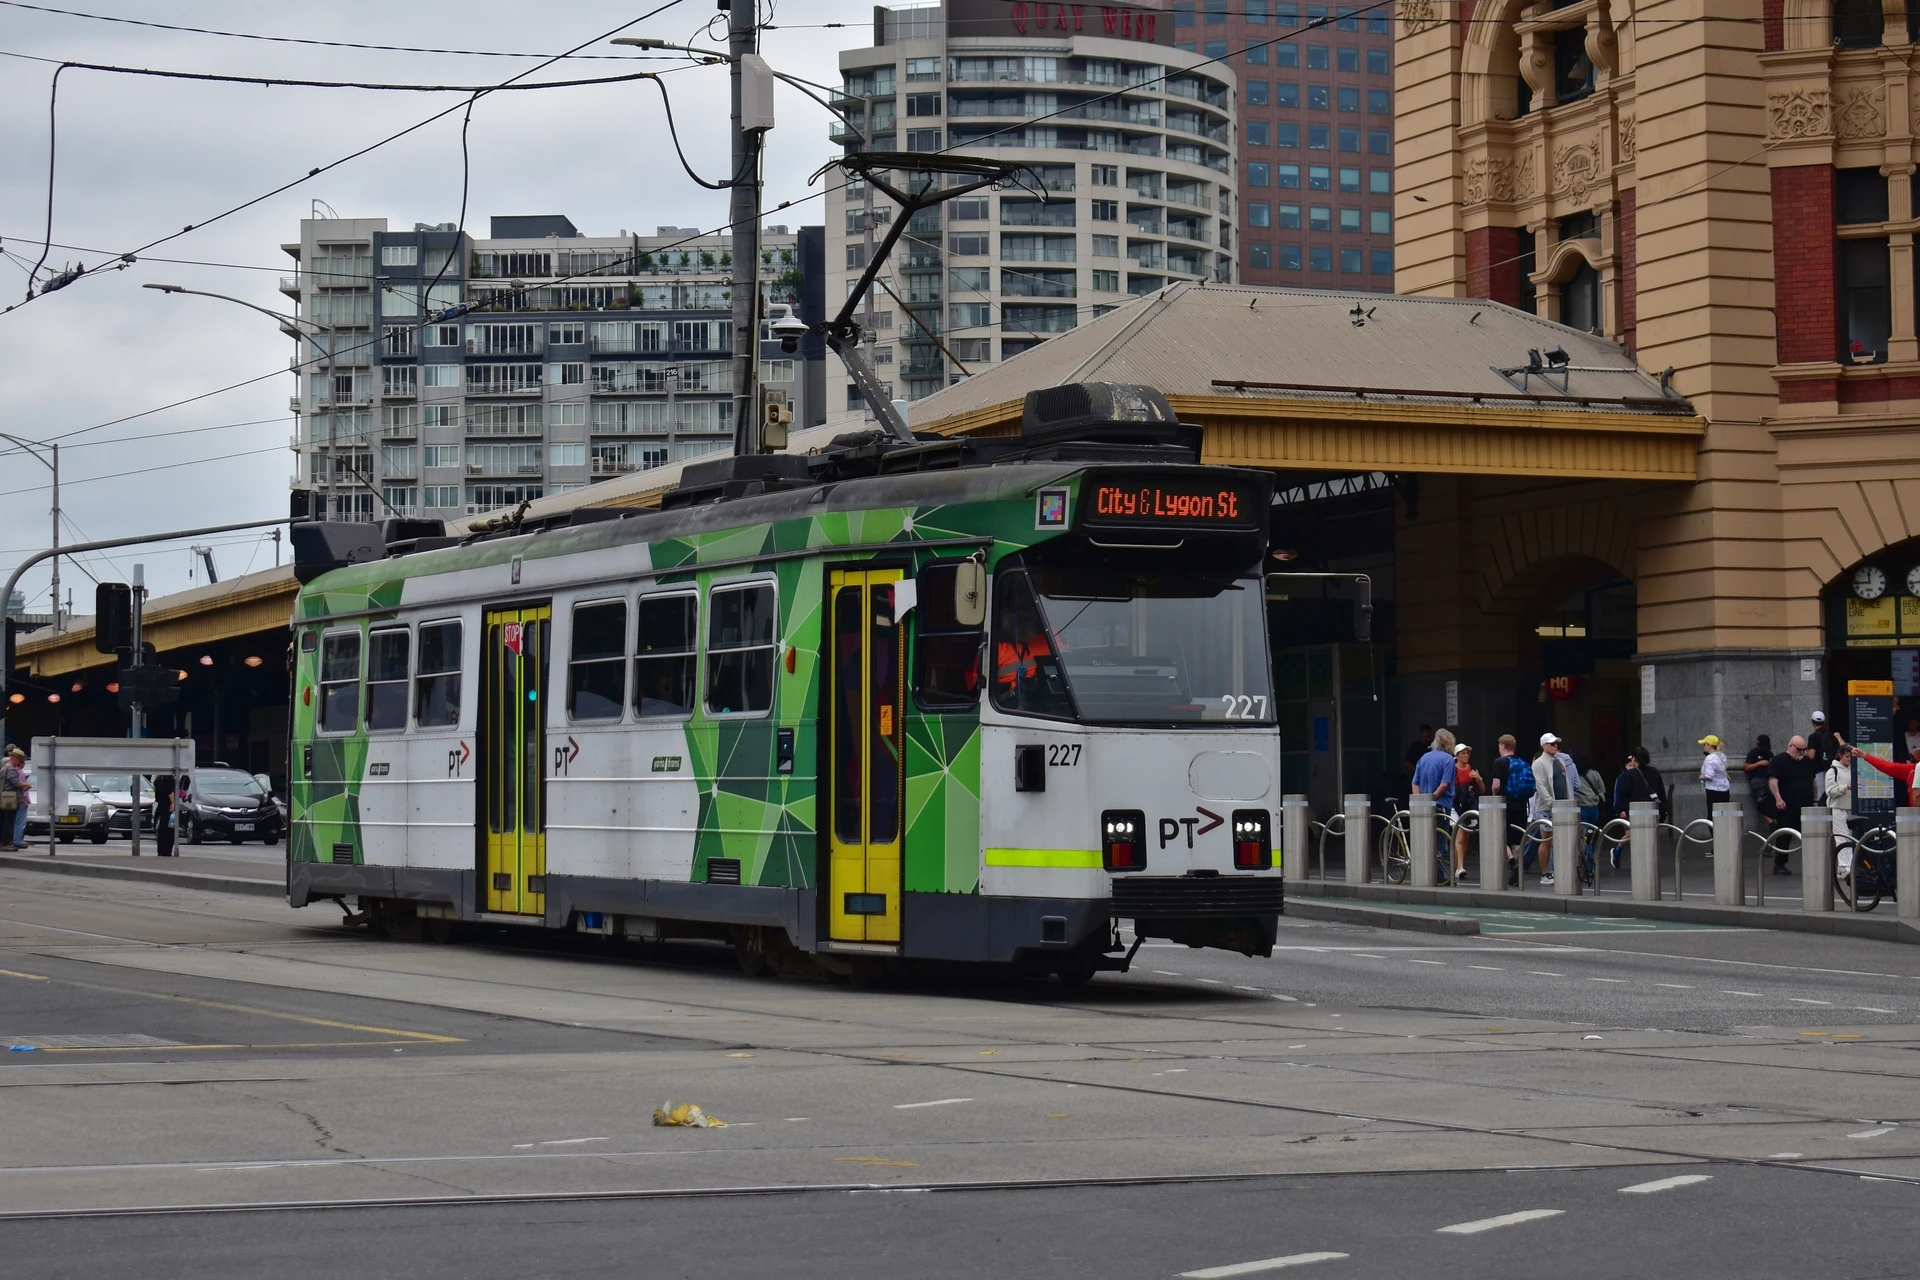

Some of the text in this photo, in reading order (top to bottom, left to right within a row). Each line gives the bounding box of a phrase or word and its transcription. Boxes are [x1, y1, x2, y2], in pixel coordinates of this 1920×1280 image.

[1012, 1, 1156, 41] QUAY WEST
[1097, 487, 1238, 518] City & Lygon St
[1849, 609, 1865, 617] LINE
[505, 624, 520, 643] STOP
[1222, 694, 1267, 719] 227
[1048, 744, 1082, 766] 227
[1160, 817, 1199, 849] PT
